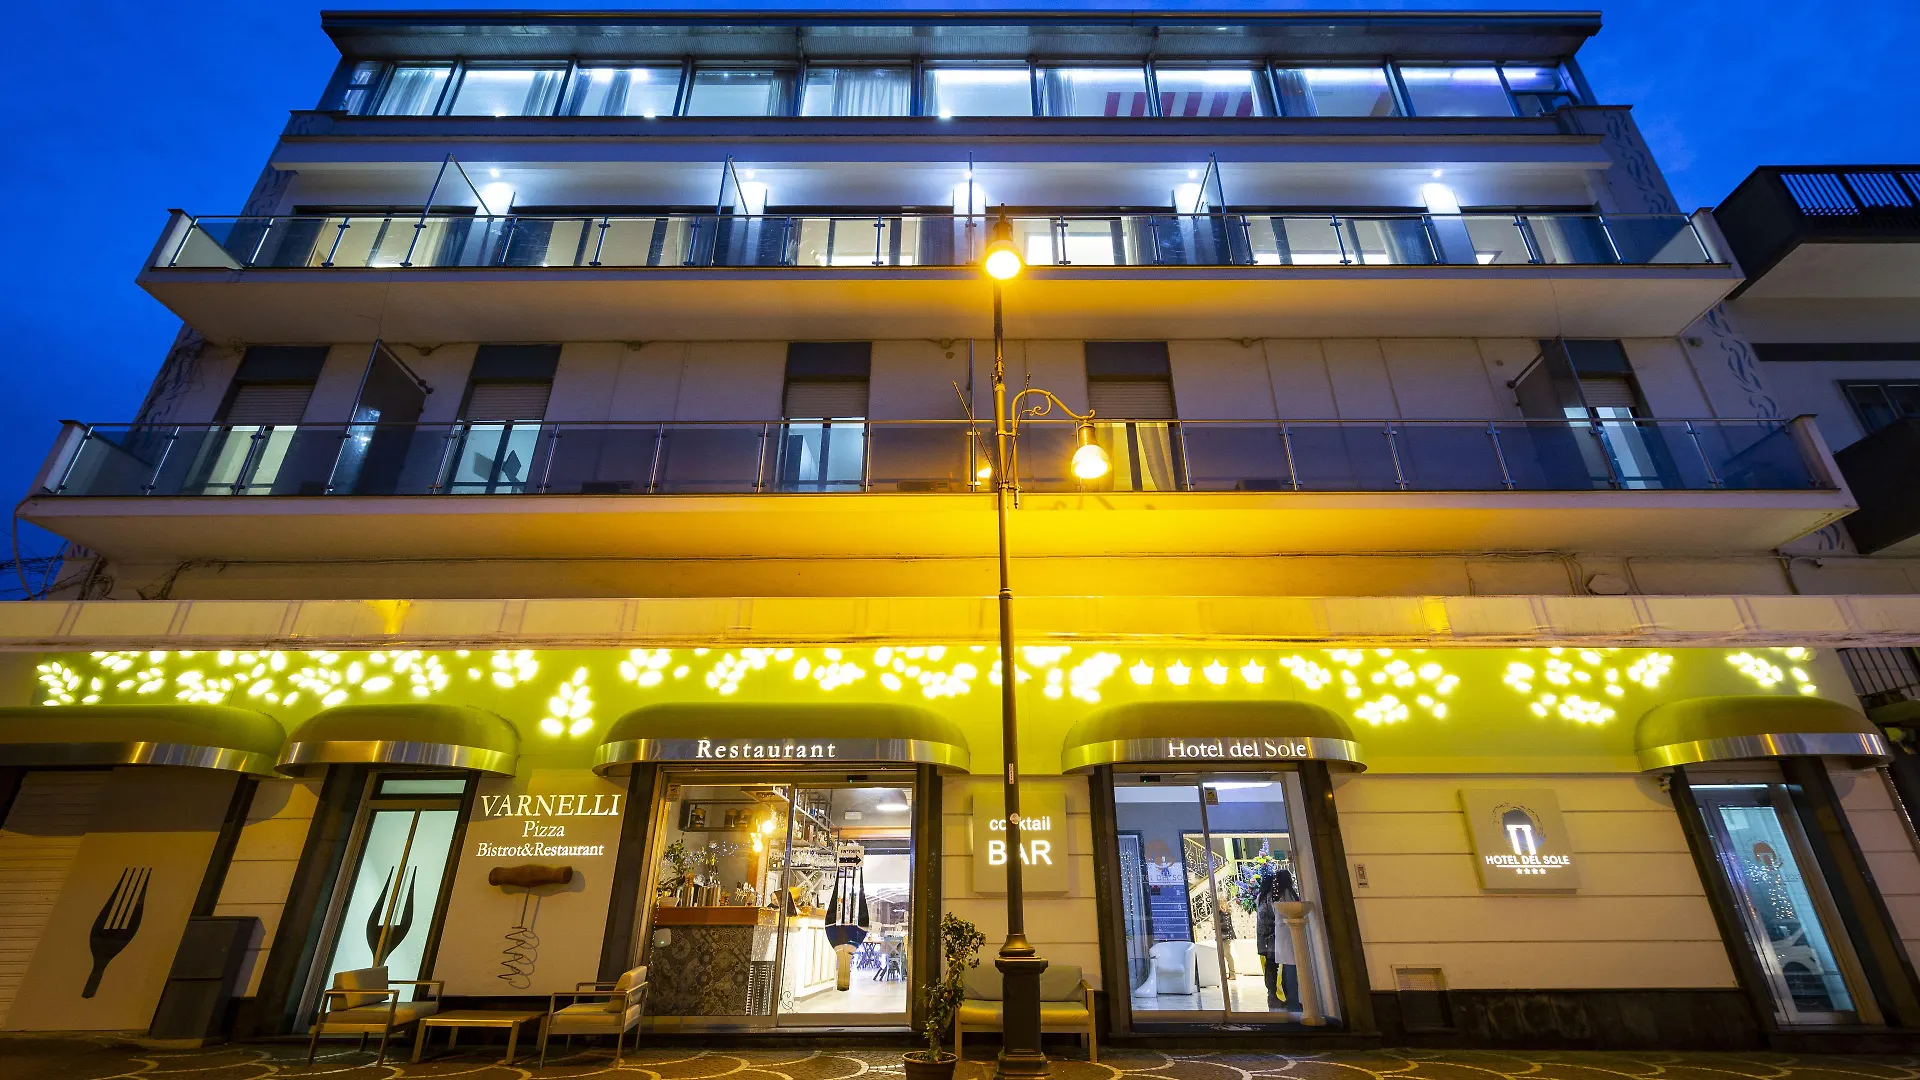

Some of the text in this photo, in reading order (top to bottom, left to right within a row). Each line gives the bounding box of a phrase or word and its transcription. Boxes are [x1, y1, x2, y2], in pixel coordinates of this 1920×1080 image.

[695, 739, 836, 758] Restaurant
[1168, 740, 1307, 758] Hotel del Sole
[481, 794, 621, 817] VARNELLI
[521, 820, 565, 838] Pizza
[989, 816, 1051, 831] coktail
[476, 842, 604, 857] Bistrot&Restaurant
[1485, 855, 1570, 865] HOTEL DEL SOLE
